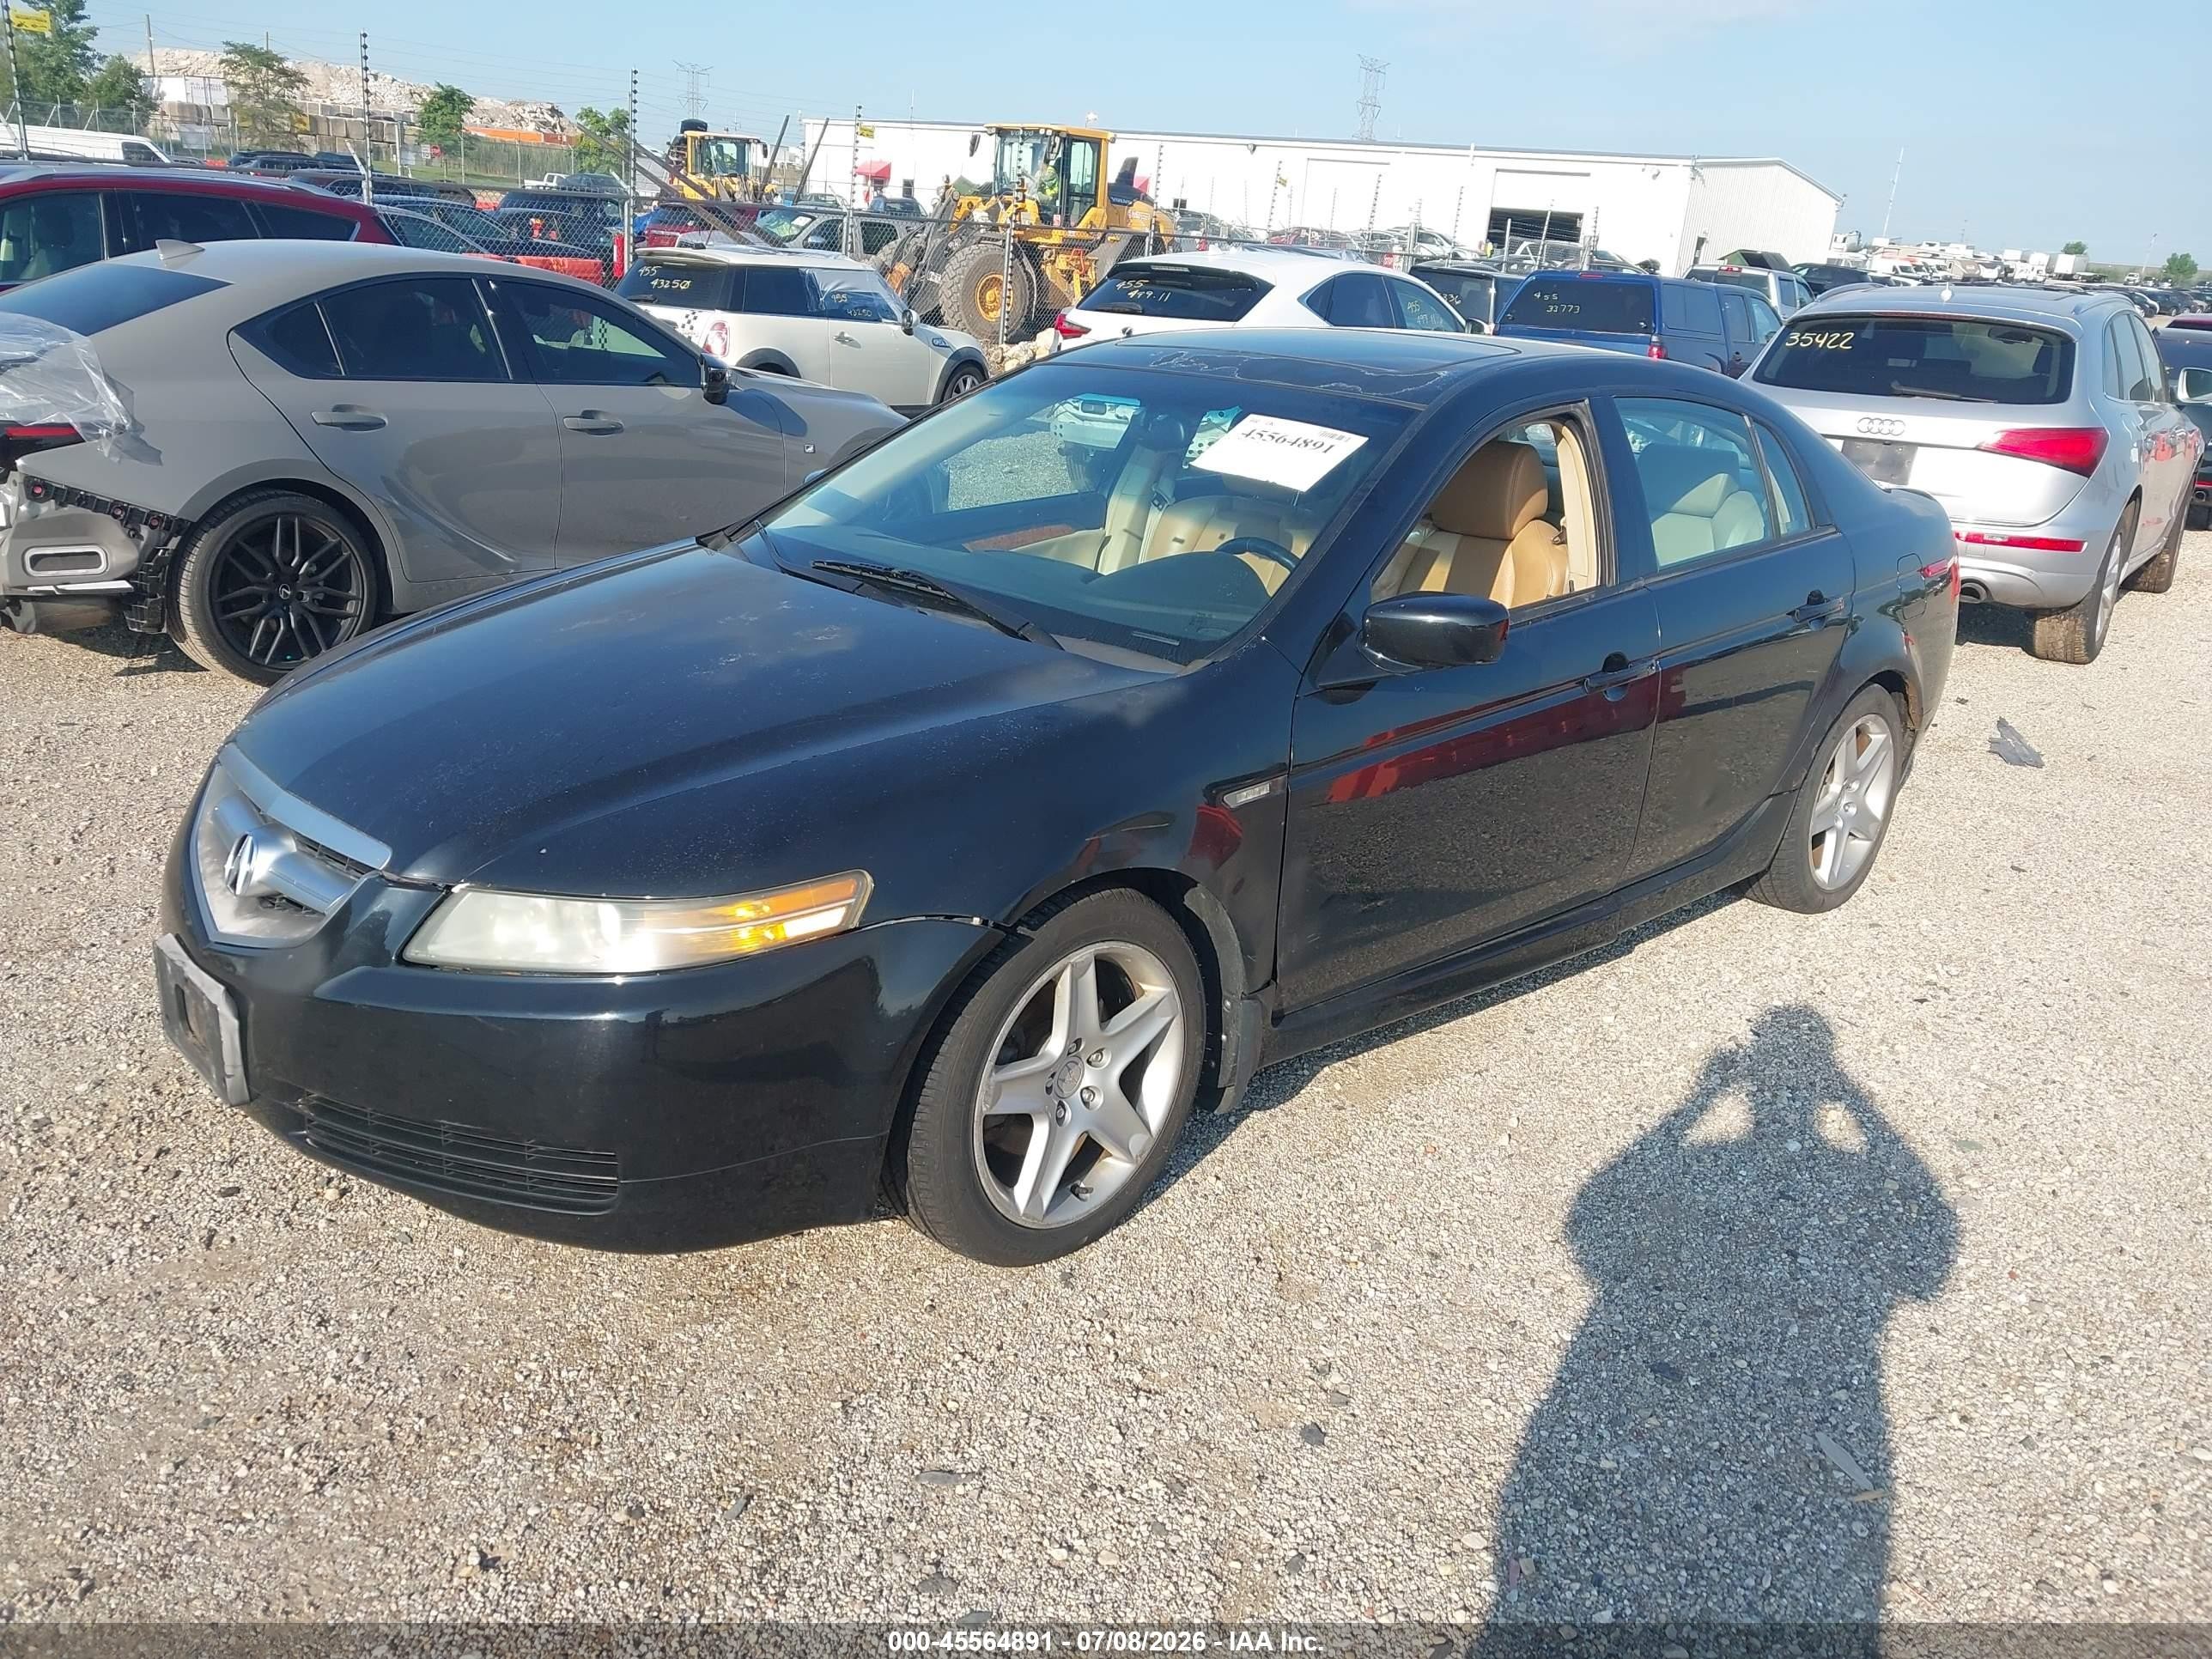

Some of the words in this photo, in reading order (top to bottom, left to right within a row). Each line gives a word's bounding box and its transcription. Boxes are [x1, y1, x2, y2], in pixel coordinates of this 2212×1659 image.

[638, 265, 662, 277] 455
[1116, 279, 1149, 290] 455
[1547, 304, 1581, 314] 33773
[1785, 331, 1855, 349] 35422
[1242, 428, 1336, 454] 45564891
